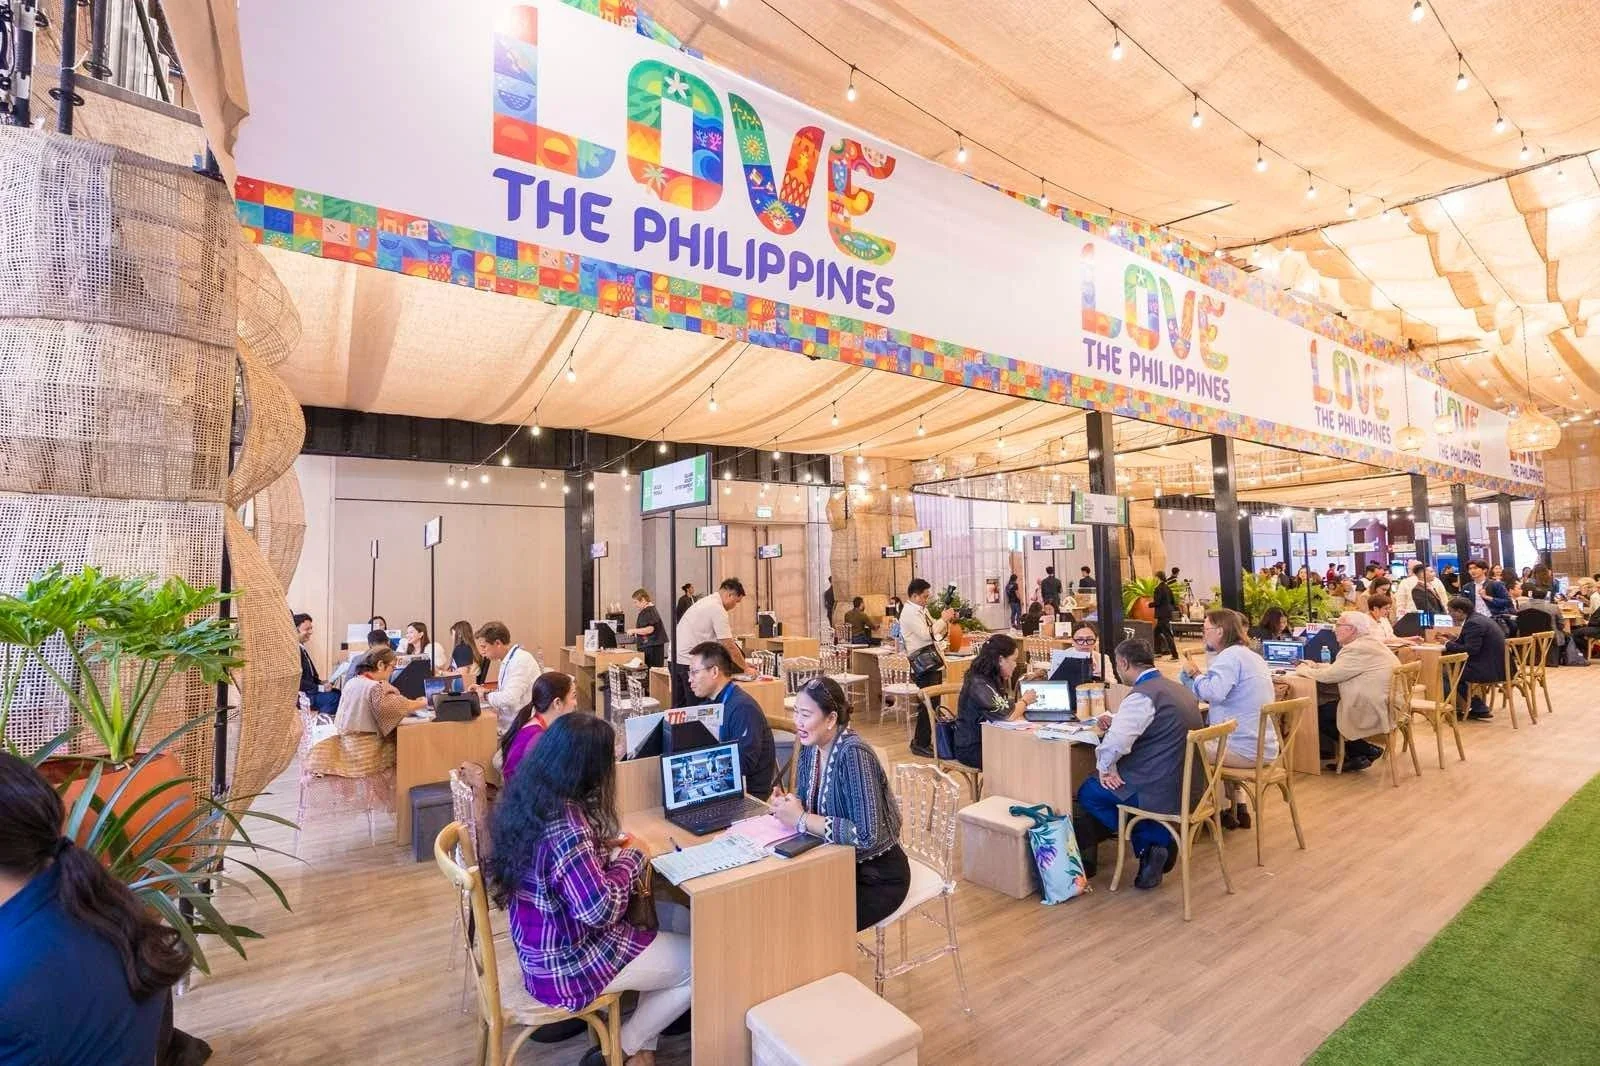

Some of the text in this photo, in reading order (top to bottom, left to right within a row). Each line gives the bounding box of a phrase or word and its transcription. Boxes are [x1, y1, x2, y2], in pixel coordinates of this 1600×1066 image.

[493, 5, 897, 265] LOVE
[493, 168, 896, 315] THE PHILIPPINES
[1081, 243, 1229, 371] LOVE
[1082, 338, 1231, 403] THE PHILIPPINES
[1310, 339, 1390, 421] LOVE
[1315, 406, 1391, 444] THE PHILIPPINES
